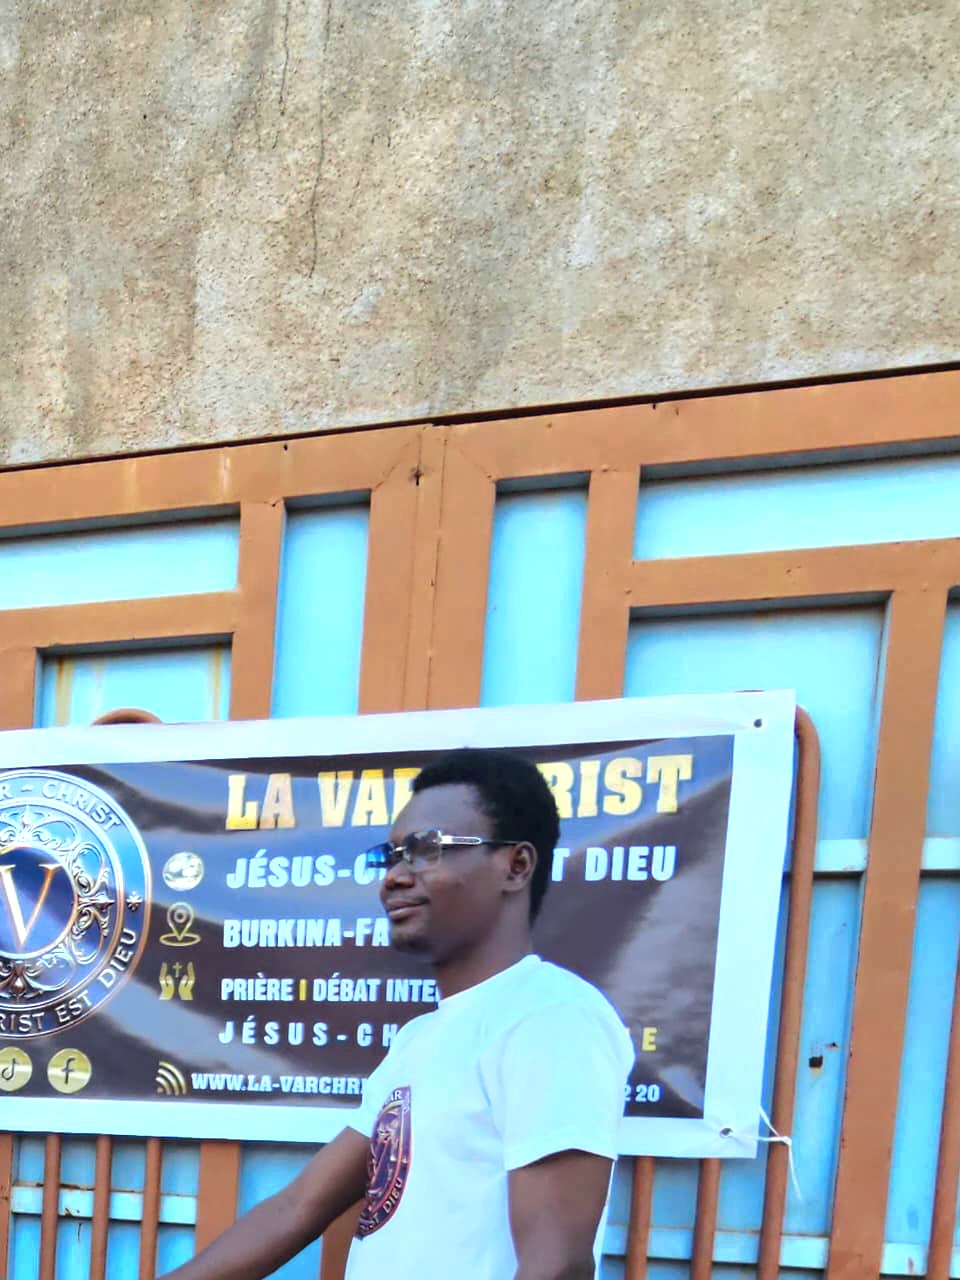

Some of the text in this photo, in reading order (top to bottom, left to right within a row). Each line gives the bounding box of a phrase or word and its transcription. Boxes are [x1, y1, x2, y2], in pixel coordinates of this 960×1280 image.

[42, 781, 121, 831] CHRIST
[226, 773, 296, 829] LA
[536, 755, 693, 818] RIST
[226, 848, 387, 888] JÉSUS-C
[585, 846, 677, 881] DIEU
[223, 918, 390, 948] BURKINA-FA
[57, 990, 91, 1023] EST
[98, 928, 137, 988] DIEU
[221, 972, 294, 1001] PRIÈRE
[313, 972, 381, 1002] DÉBAT
[386, 978, 440, 1002] INTE
[192, 1073, 368, 1095] WWW.LA-VARCHR
[635, 1084, 660, 1102] 20
